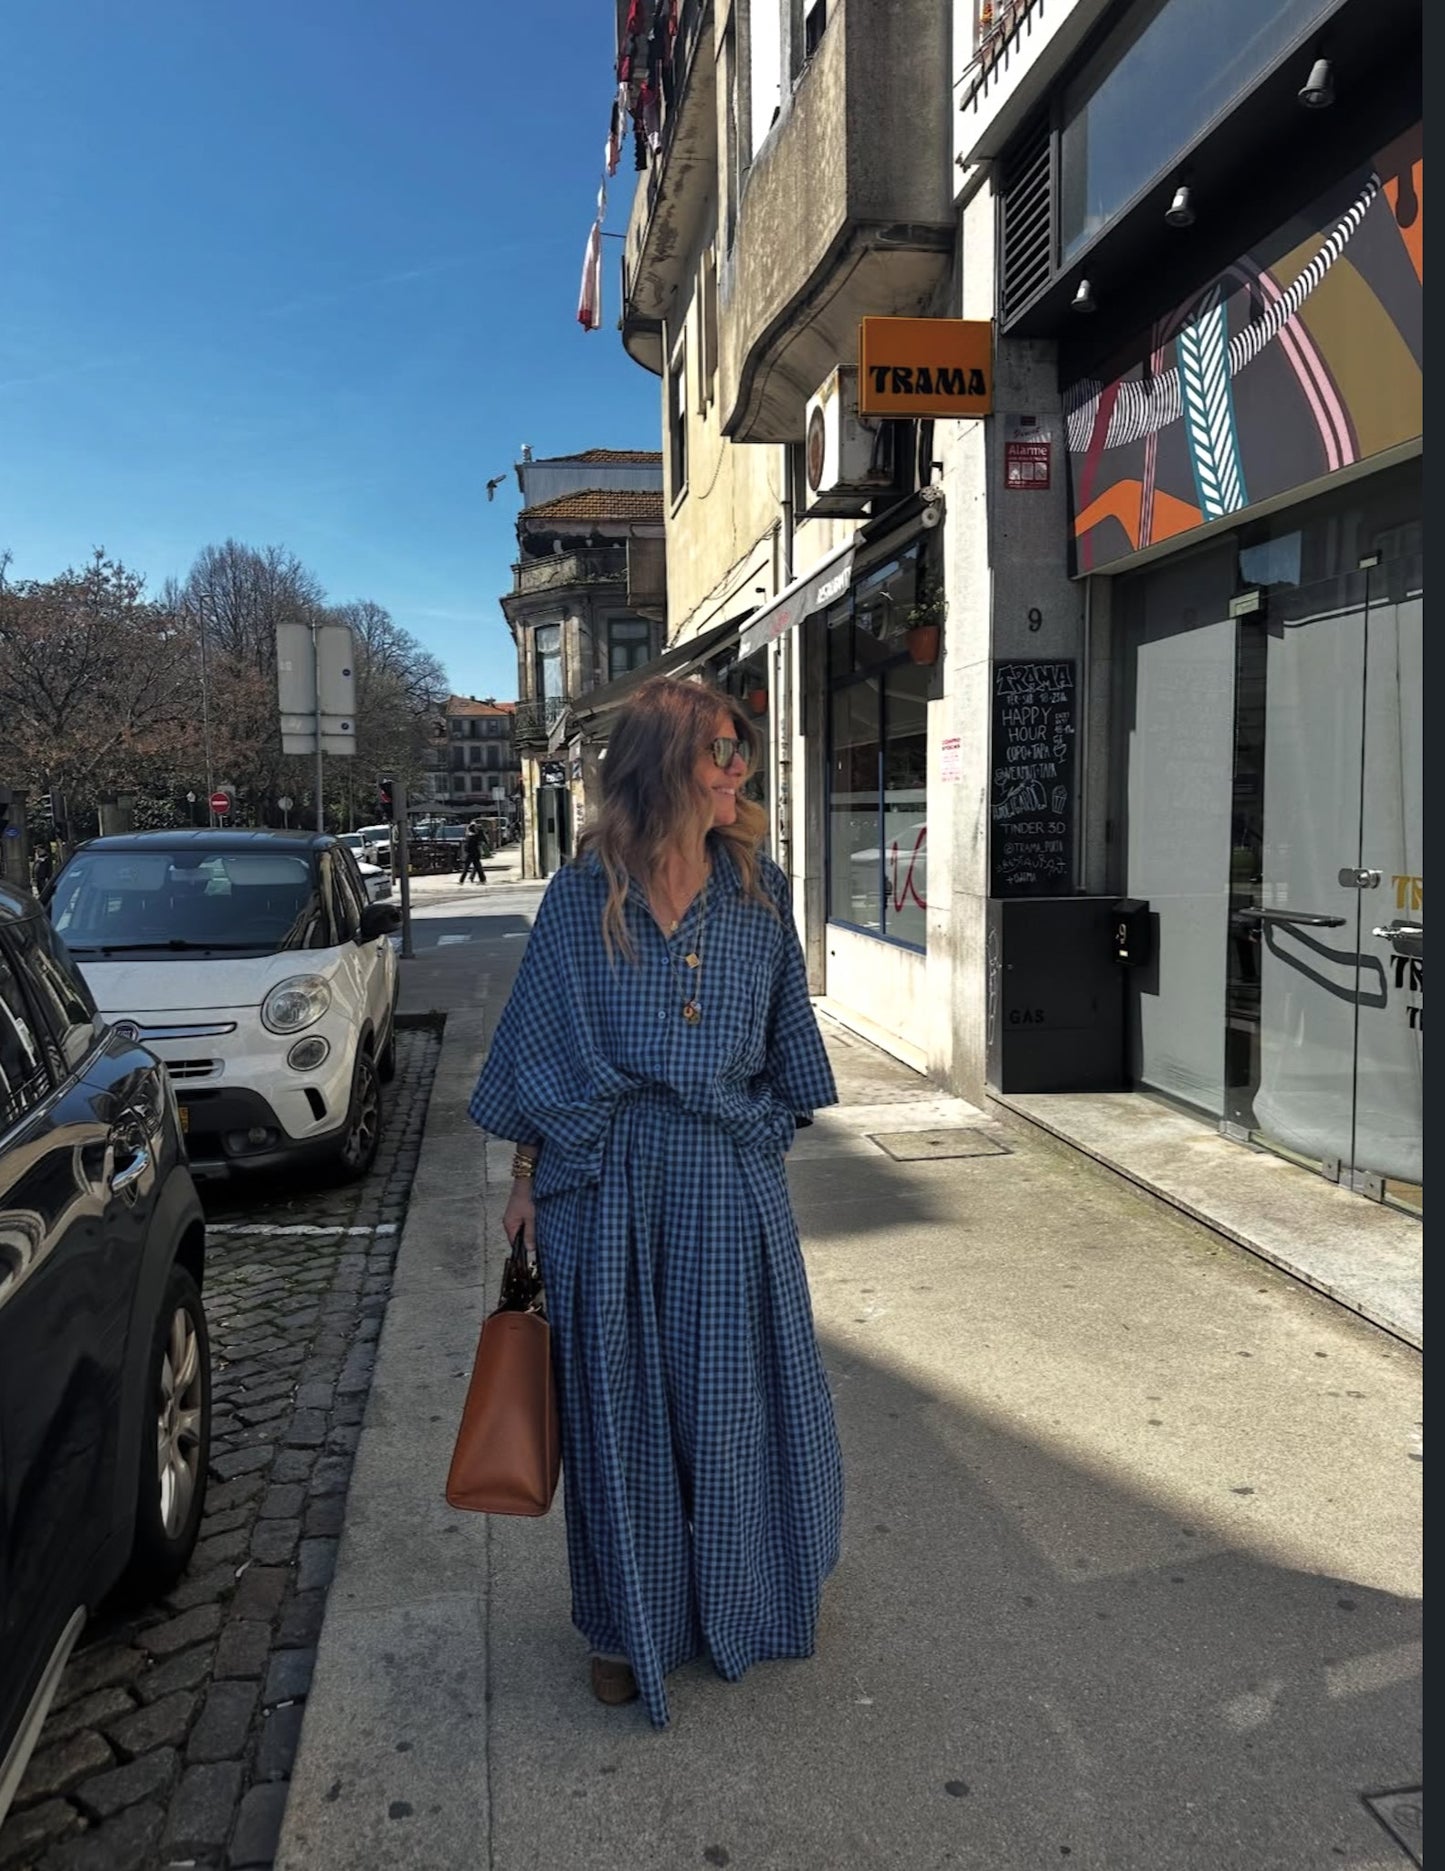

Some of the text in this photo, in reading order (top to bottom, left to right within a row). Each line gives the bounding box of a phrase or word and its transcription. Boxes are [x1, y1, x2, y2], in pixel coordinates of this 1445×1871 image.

[869, 366, 987, 396] TRAMA
[1008, 444, 1048, 456] Alarme
[1028, 607, 1042, 632] 9
[996, 663, 1074, 695] TRAMA
[1002, 707, 1052, 725] HAPPY
[1008, 725, 1047, 742] HOUR
[1000, 822, 1066, 834] TINDER 3D
[1009, 1008, 1045, 1025] GAS
